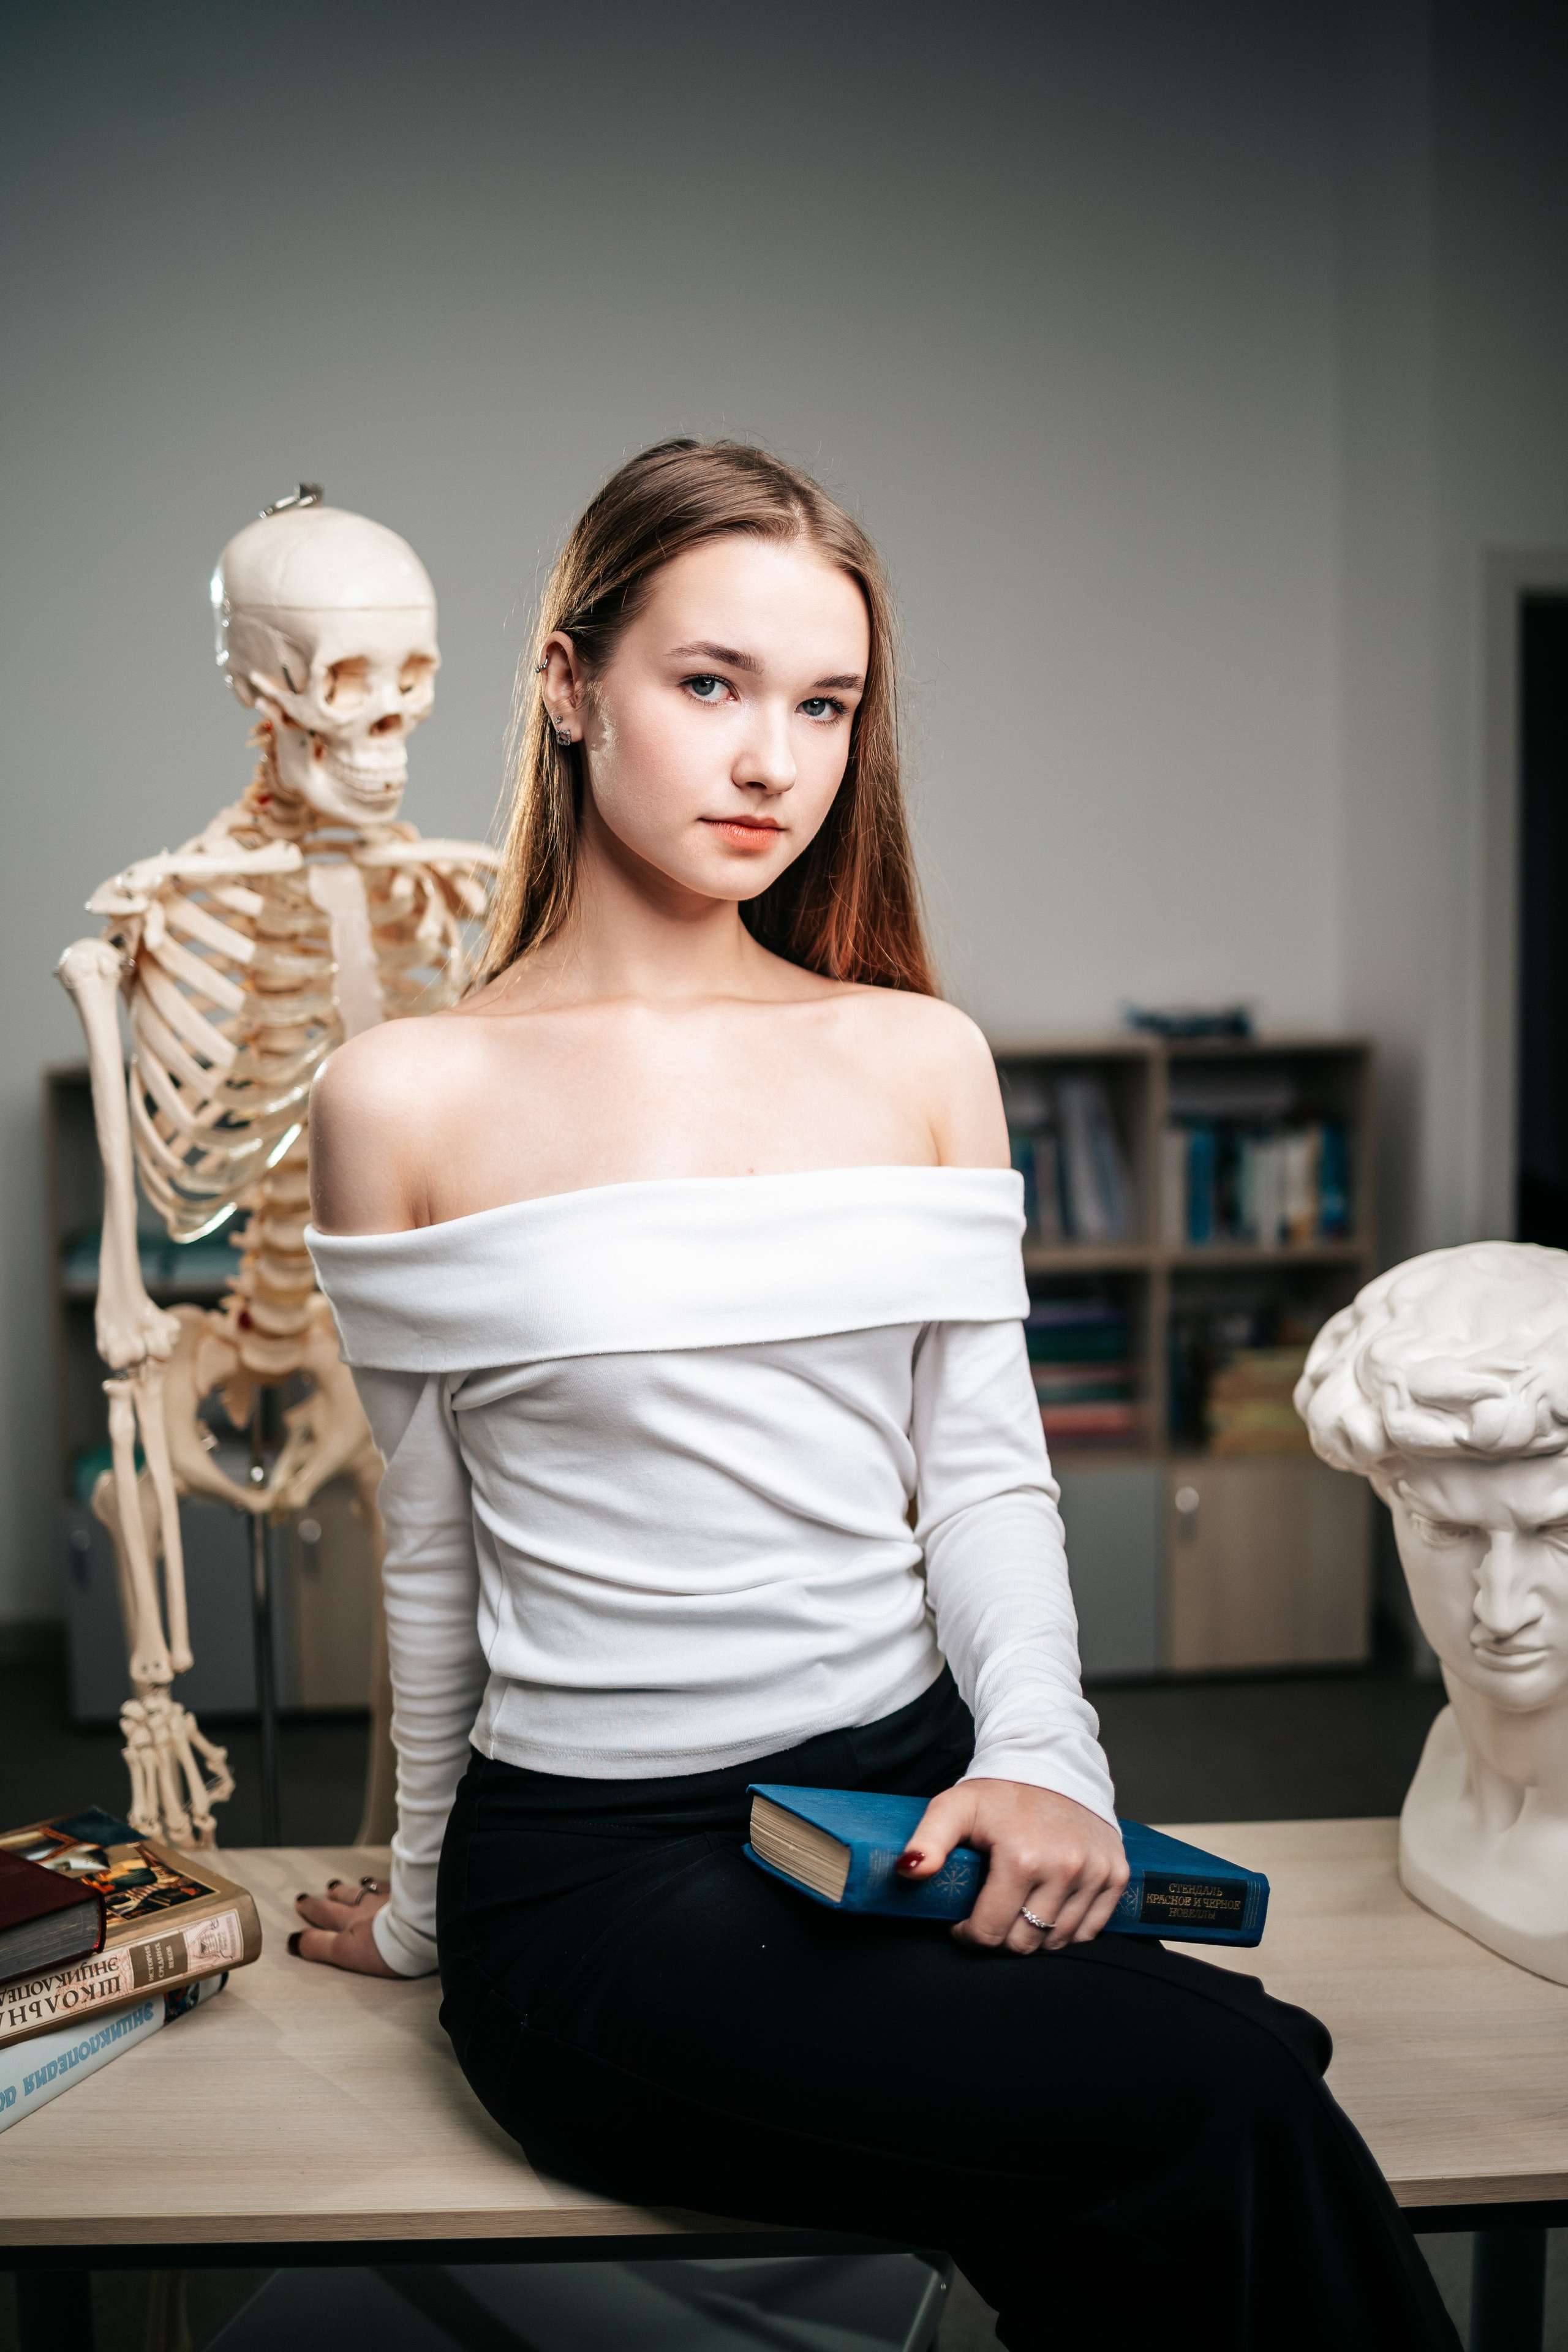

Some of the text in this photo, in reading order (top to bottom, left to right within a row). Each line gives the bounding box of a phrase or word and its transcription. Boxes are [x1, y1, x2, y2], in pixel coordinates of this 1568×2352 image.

[1169, 1883, 1223, 1896] СТЕНДАЛЬ
[1146, 1893, 1241, 1910] КРАСНОЕ И ЧЕРНОЕ
[1169, 1907, 1216, 1920] НОВЕЛЛЫ
[23, 2002, 154, 2097] ЭНЦИКЛОПЕДИЯ
